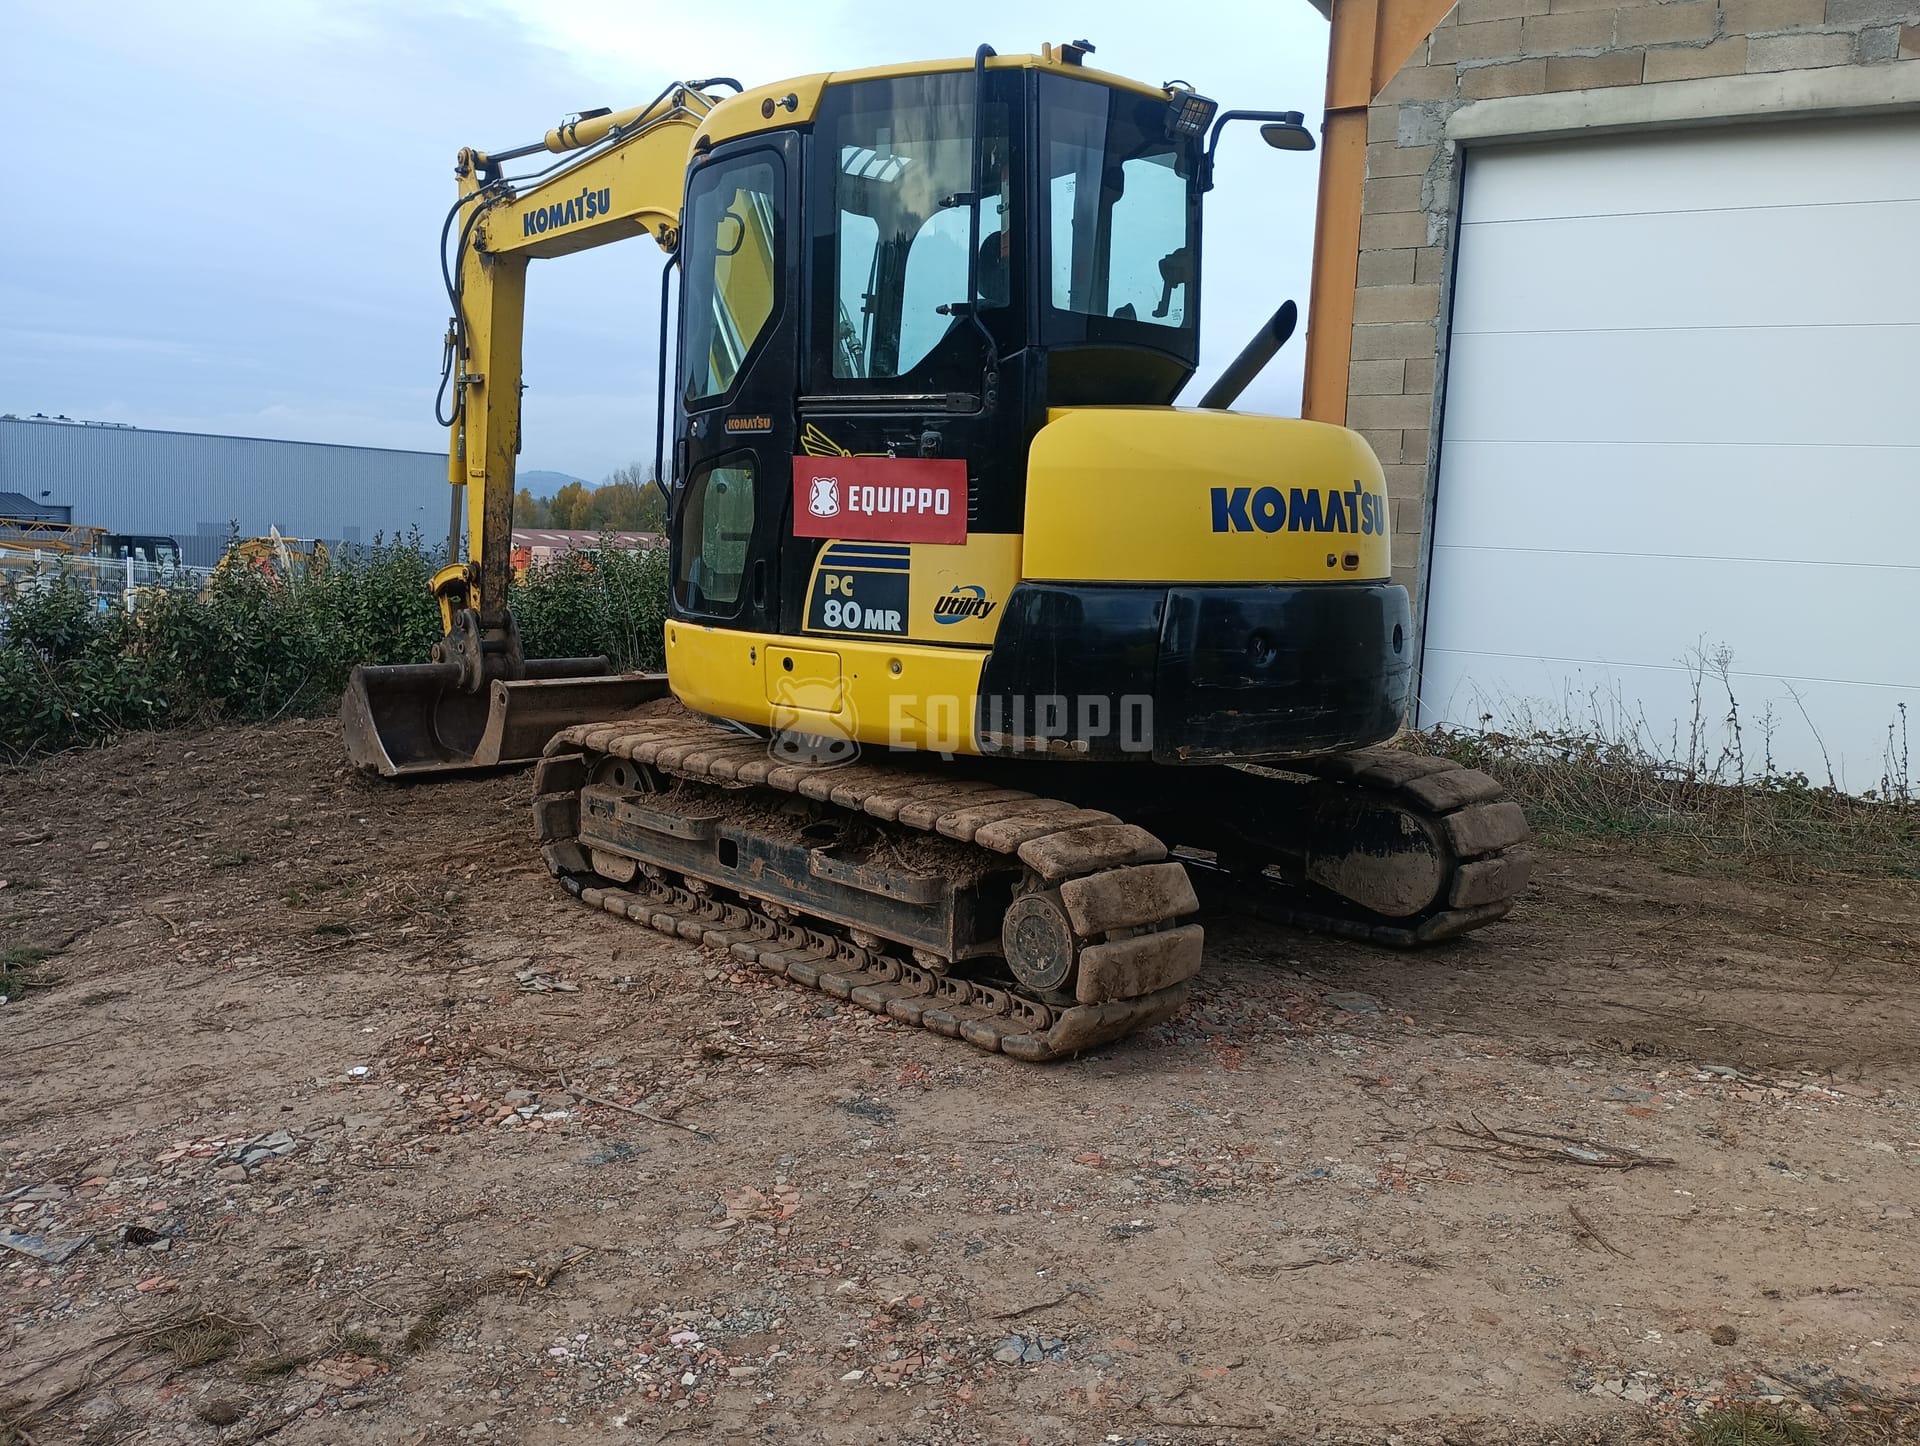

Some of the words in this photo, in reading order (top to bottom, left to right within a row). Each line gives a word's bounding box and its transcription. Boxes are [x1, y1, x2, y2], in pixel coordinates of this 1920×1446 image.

[523, 187, 610, 237] KOMATSU
[728, 415, 770, 430] KOMATSU
[848, 485, 950, 516] EQUIPPO
[1210, 480, 1385, 536] KOMATSU
[825, 574, 853, 597] PC
[934, 595, 998, 619] Utility
